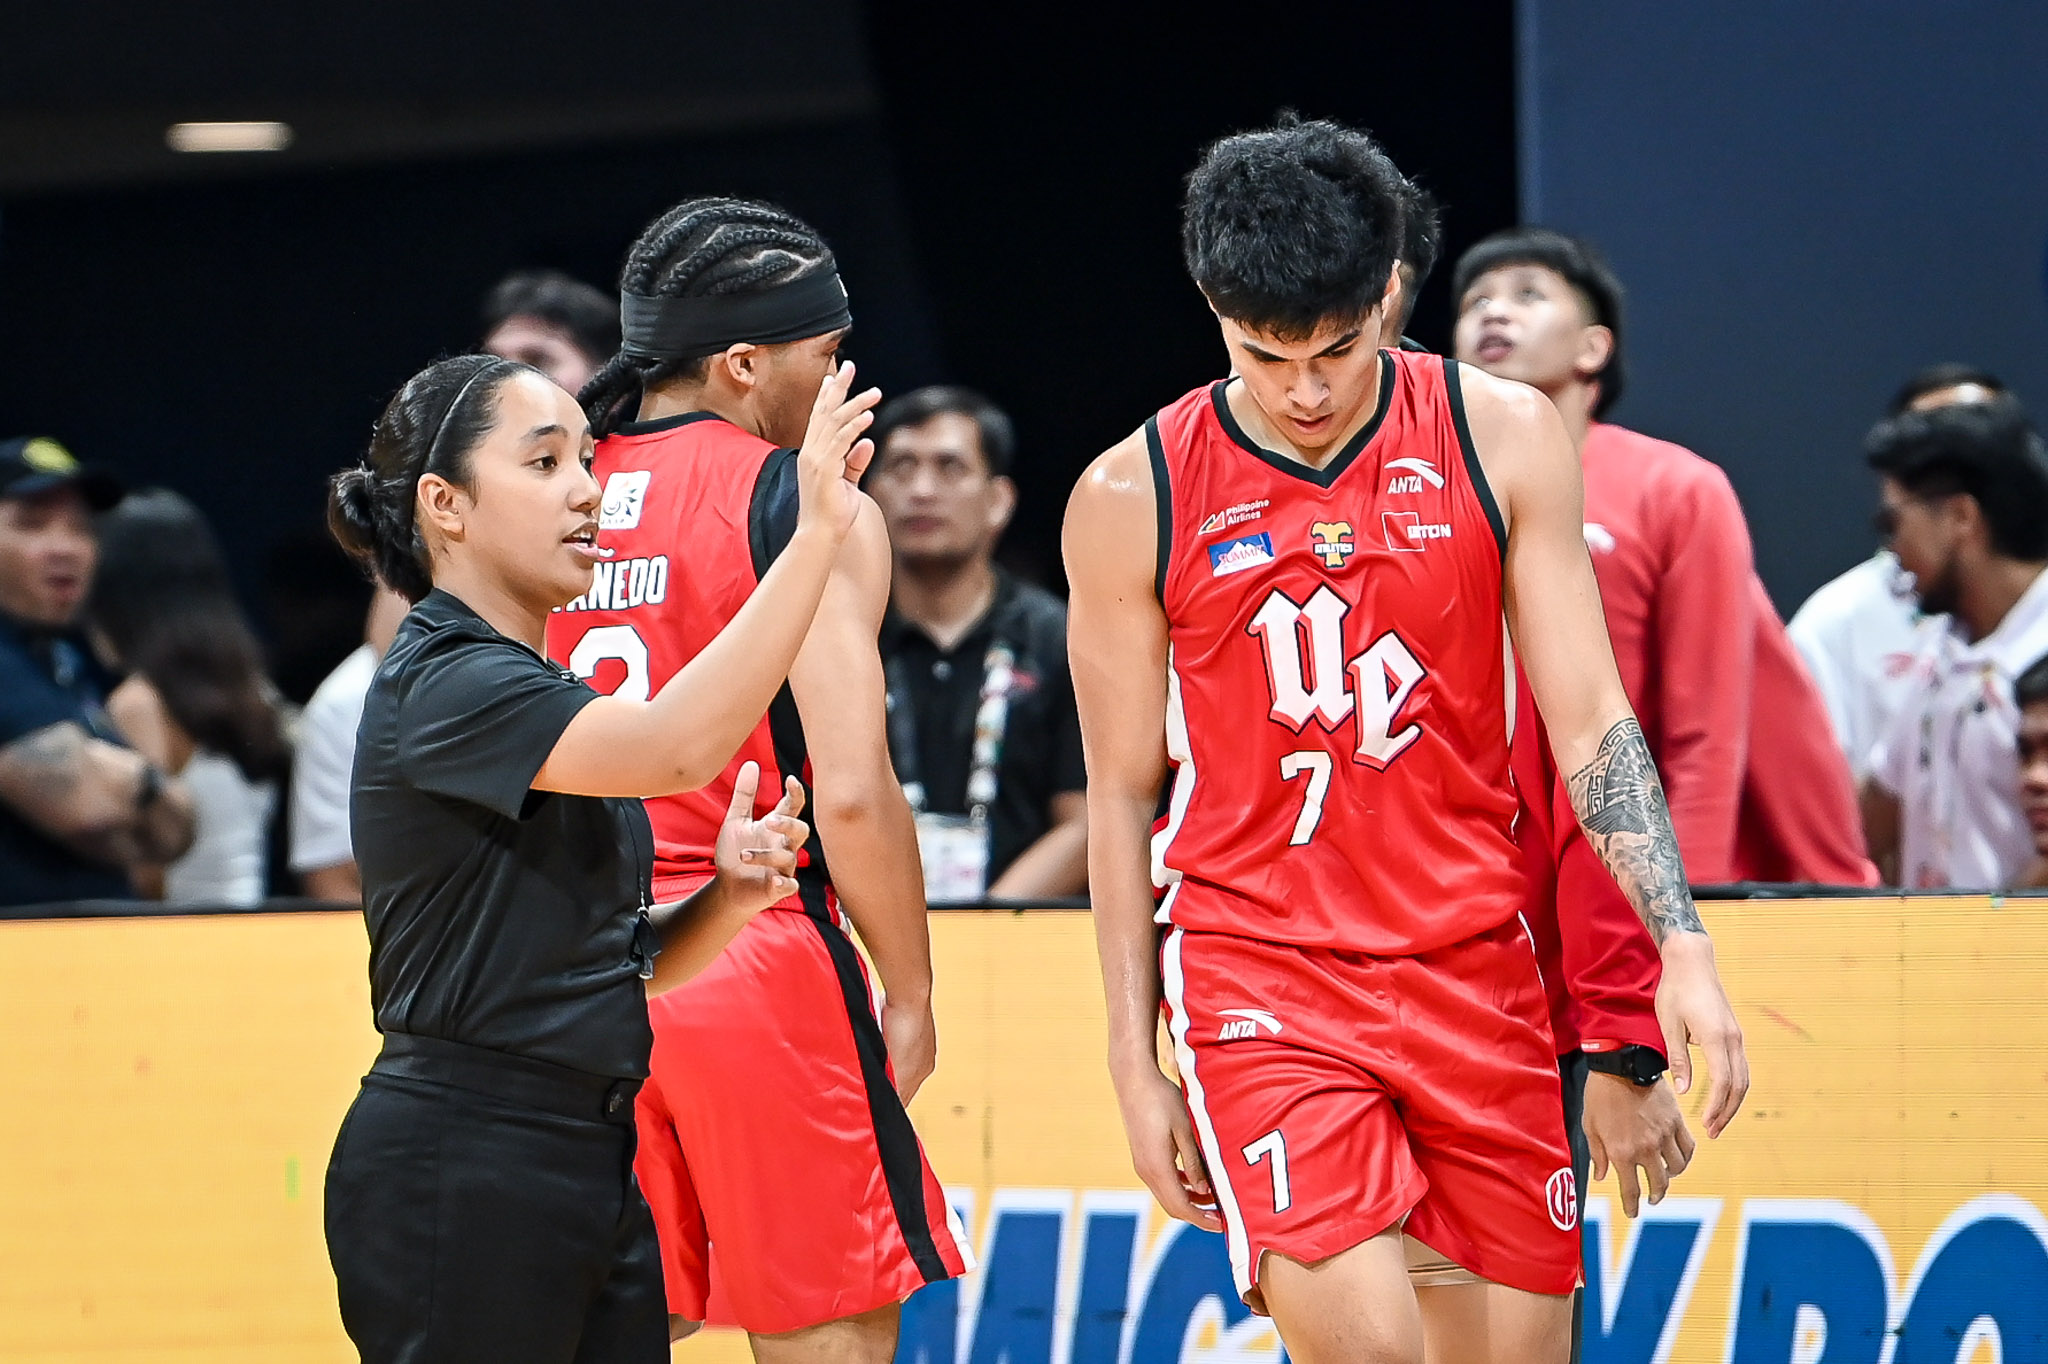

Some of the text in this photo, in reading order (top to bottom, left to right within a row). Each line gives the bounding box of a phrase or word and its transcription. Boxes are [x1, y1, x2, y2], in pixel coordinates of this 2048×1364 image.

[1387, 475, 1423, 494] ANTA
[1226, 499, 1270, 516] Philippine
[1227, 511, 1261, 526] Airlines
[1279, 750, 1333, 846] 7
[1218, 1020, 1257, 1040] ANTA
[1241, 1128, 1291, 1214] 7
